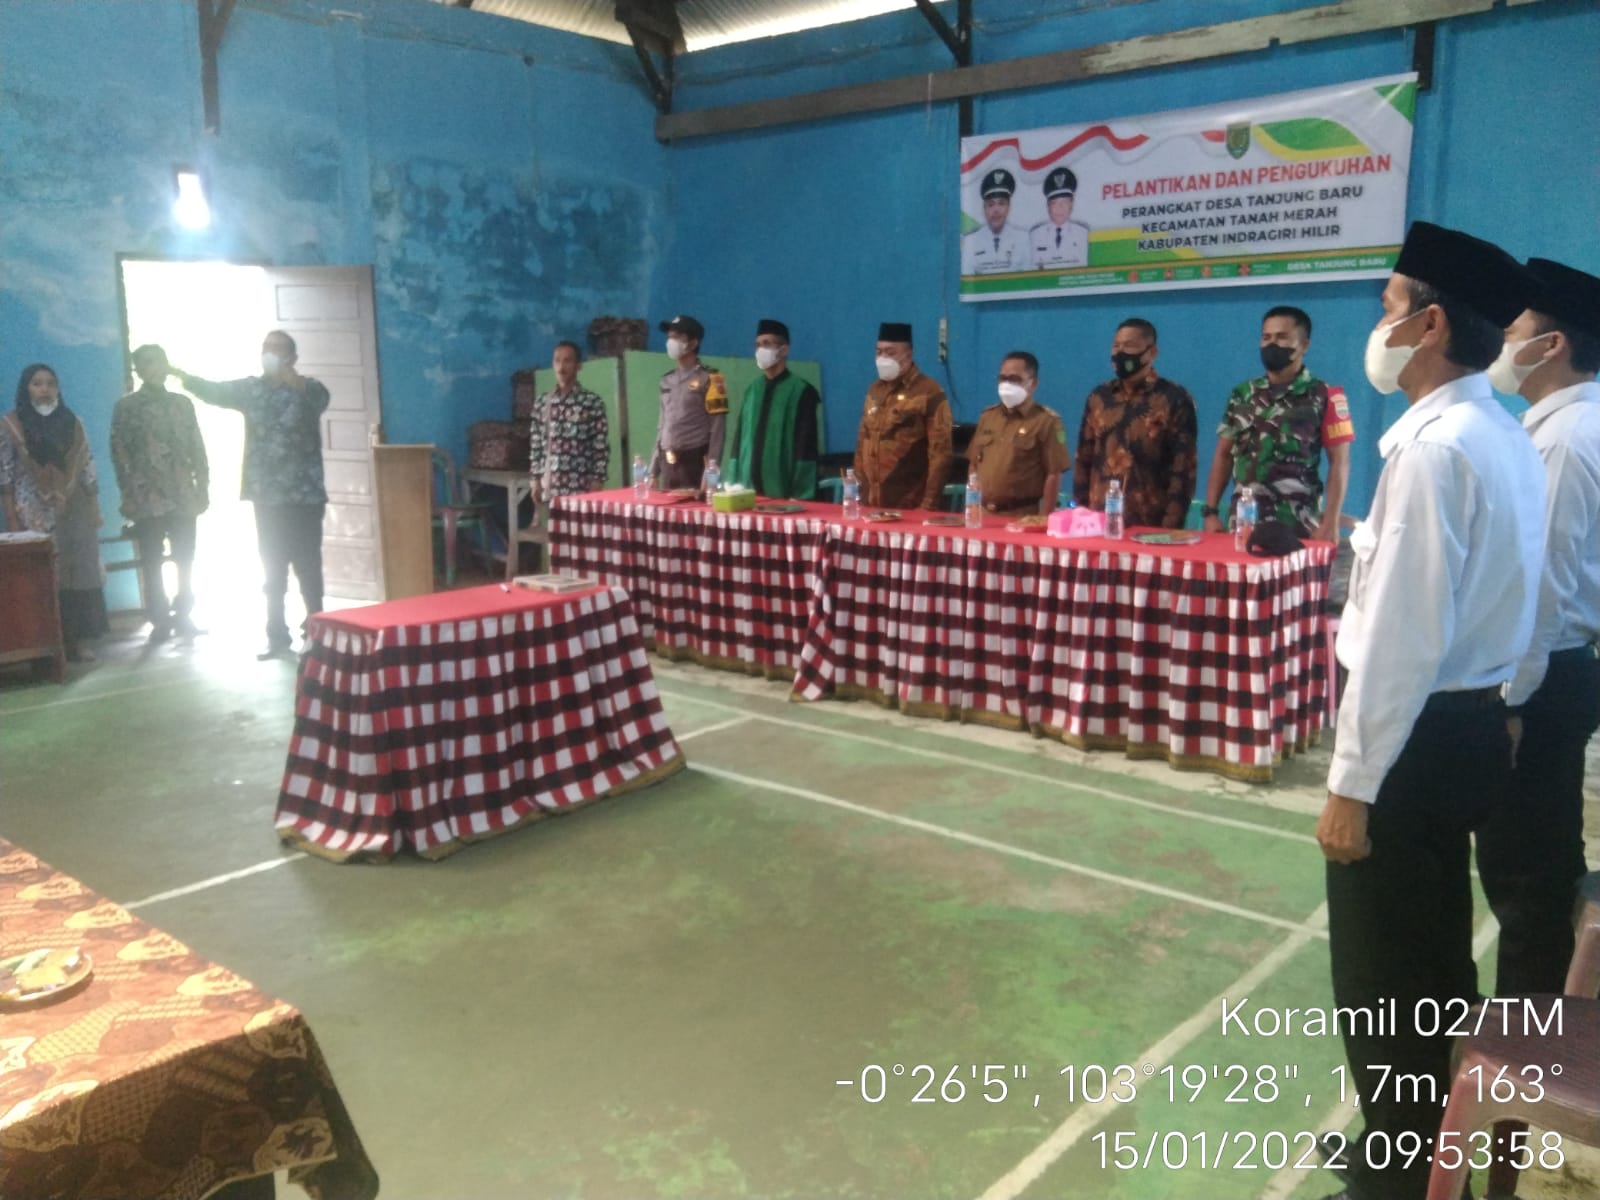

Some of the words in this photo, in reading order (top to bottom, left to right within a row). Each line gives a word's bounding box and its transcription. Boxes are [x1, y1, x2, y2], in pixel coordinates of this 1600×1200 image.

[1102, 173, 1211, 200] PELANTIKAN
[1215, 169, 1252, 189] DAN
[1257, 154, 1392, 184] PENGUKUHAN
[1122, 200, 1202, 219] PERANGKAT
[1205, 197, 1243, 212] DESA
[1246, 190, 1315, 208] TANJUNG
[1319, 185, 1364, 201] BARU
[1141, 217, 1226, 234] KECAMATAN
[1230, 212, 1279, 228] TANAH
[1283, 206, 1338, 222] MERAH
[1137, 234, 1219, 251] KABUPATEN
[1222, 227, 1297, 243] INDRAGIRI
[1301, 224, 1341, 238] HILIR
